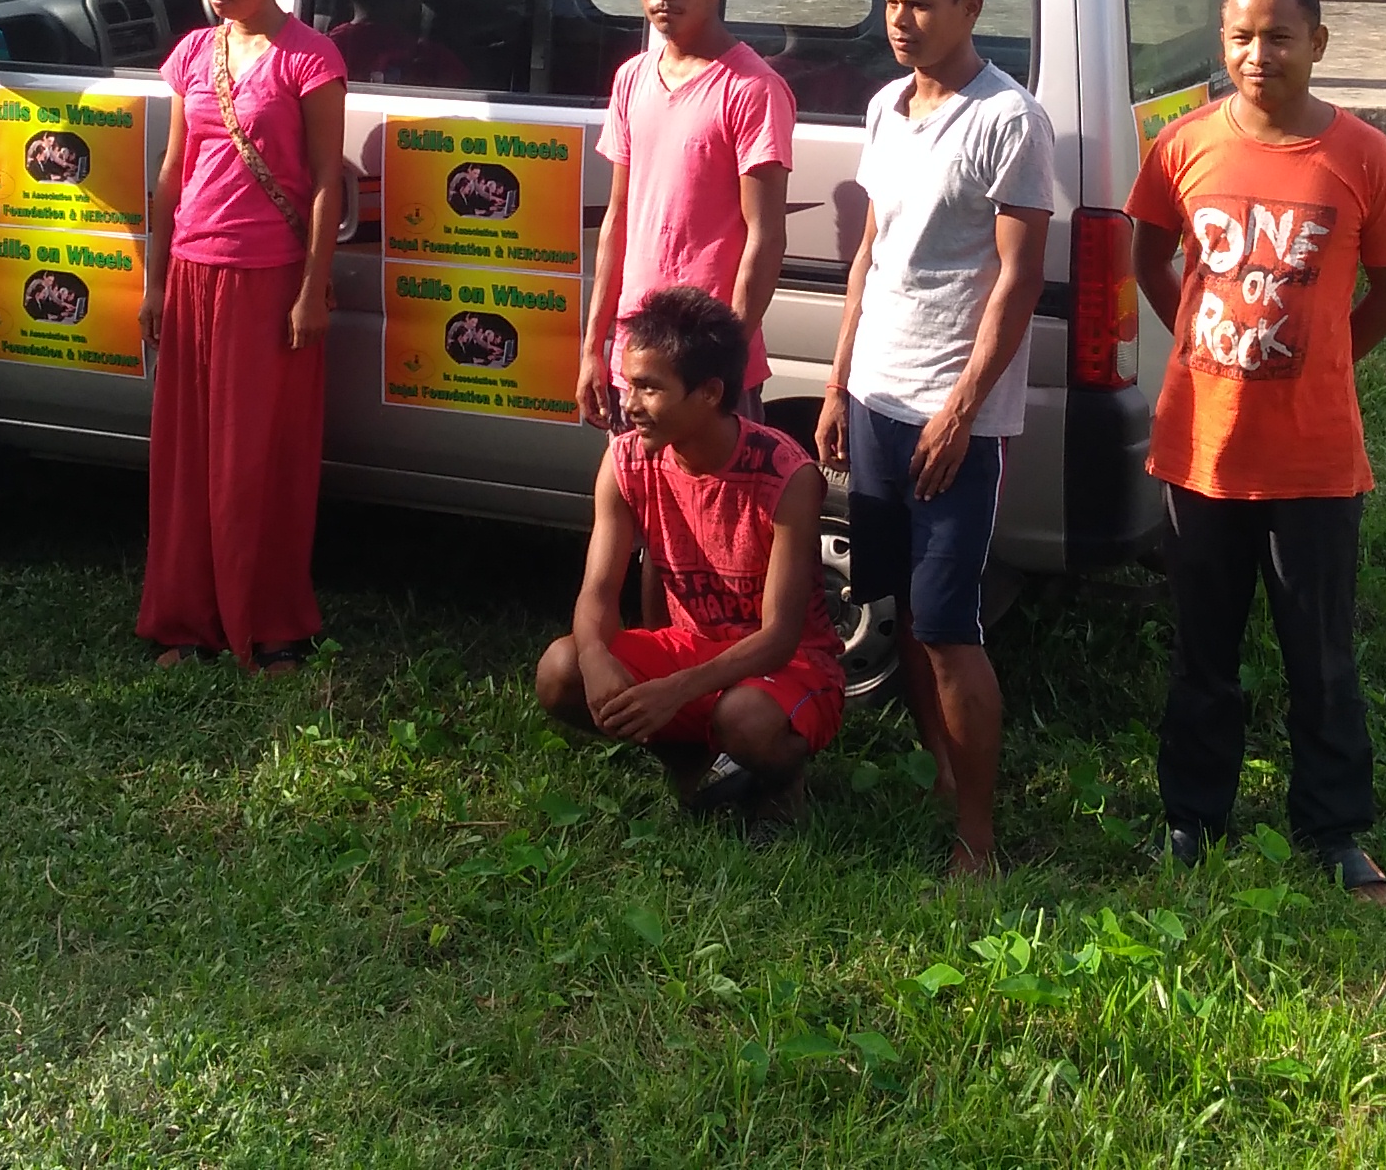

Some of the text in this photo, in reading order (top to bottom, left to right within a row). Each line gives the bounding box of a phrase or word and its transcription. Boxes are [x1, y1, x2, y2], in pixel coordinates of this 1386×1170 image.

[37, 106, 61, 123] on
[66, 104, 133, 128] Wheels
[397, 128, 569, 160] Skills on Wheels
[23, 191, 30, 199] In
[31, 192, 72, 201] Association
[3, 204, 66, 221] Foundation
[69, 210, 77, 221] &
[443, 225, 452, 234] In
[453, 225, 499, 238] Association
[1193, 203, 1330, 273] ONE
[36, 245, 60, 264] on
[66, 245, 133, 271] Wheels
[422, 239, 491, 258] Foundation
[494, 245, 504, 258] &
[396, 275, 566, 312] Skills on Wheels
[1242, 271, 1289, 309] OK
[20, 329, 28, 337] In
[29, 330, 69, 342] Association
[1195, 291, 1293, 371] ROCK
[2, 341, 63, 359] Foundation
[66, 348, 75, 360] &
[442, 372, 451, 382] In
[453, 374, 498, 387] Association
[422, 386, 490, 406] Foundation
[494, 393, 504, 407] &
